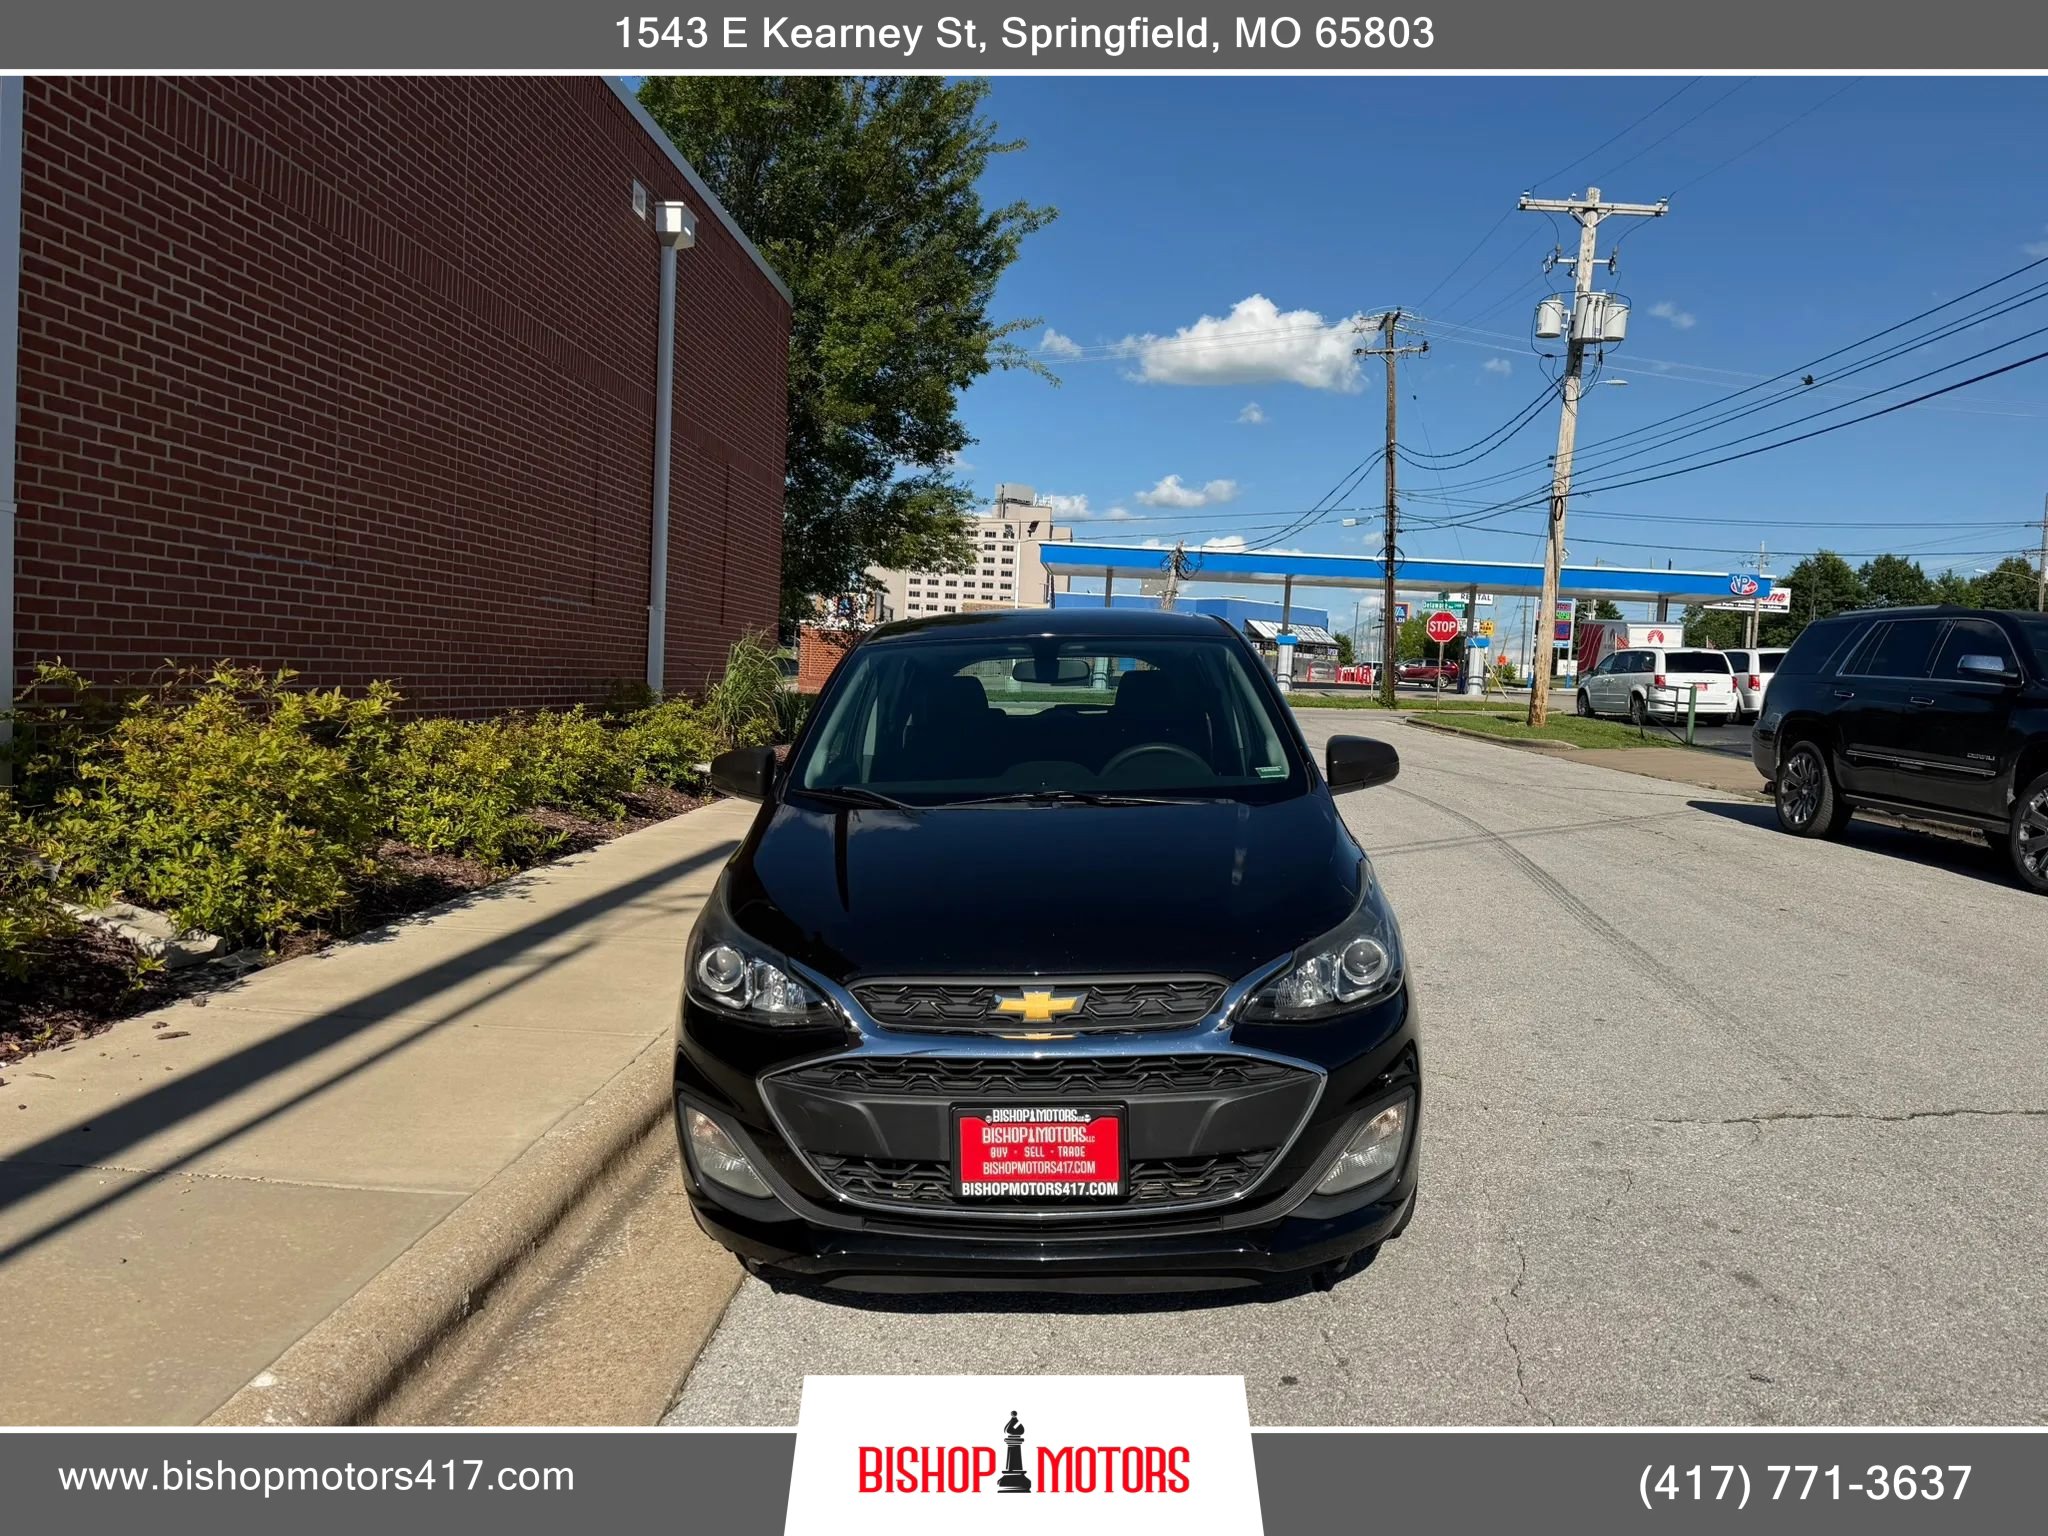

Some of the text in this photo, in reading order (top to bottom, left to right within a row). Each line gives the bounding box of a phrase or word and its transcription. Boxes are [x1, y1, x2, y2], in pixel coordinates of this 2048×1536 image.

[1732, 575, 1750, 593] VP
[1461, 592, 1491, 601] RETAL
[1429, 620, 1456, 633] STOP
[992, 1109, 1029, 1122] BISHOP
[1036, 1108, 1077, 1122] MOTORS
[982, 1126, 1096, 1144] BISHOP MOTORS LLC
[990, 1145, 1086, 1158] BUY SELL TRADE
[983, 1160, 1096, 1175] BISHOPMOTORS417.COM
[962, 1182, 1118, 1196] BISHOPMOTORS417.COM
